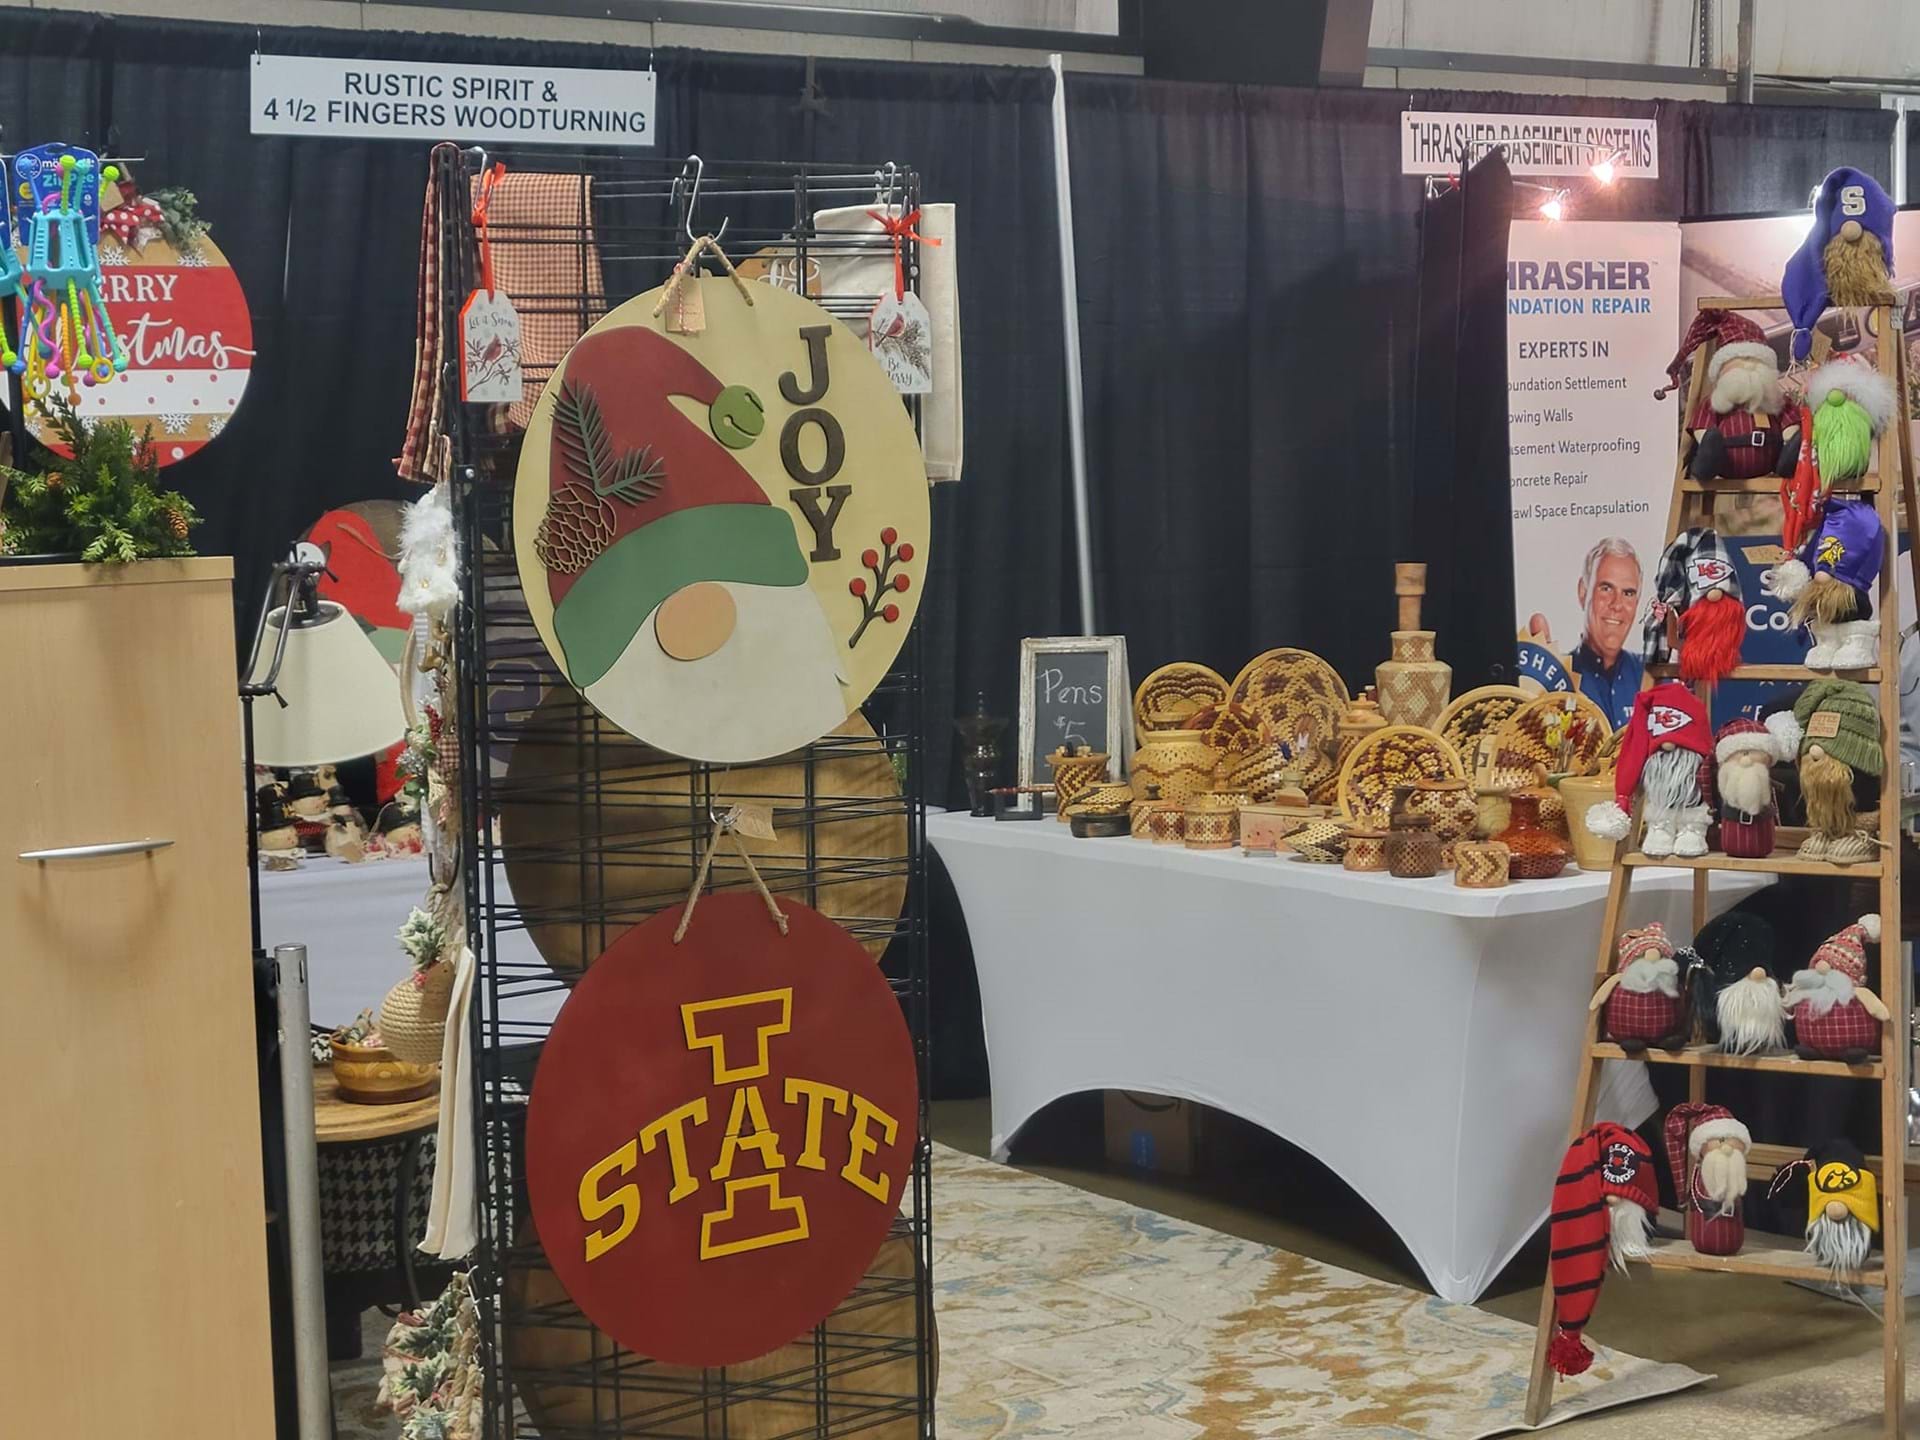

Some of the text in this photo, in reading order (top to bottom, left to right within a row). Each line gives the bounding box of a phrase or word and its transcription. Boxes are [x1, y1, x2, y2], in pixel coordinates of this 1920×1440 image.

[344, 72, 558, 102] RUSTIC SPIRIT &
[264, 98, 279, 121] 4
[328, 100, 446, 126] FINGERS
[454, 105, 646, 133] WOODTURNING
[1501, 125, 1582, 165] BASEMENT
[1841, 186, 1866, 216] S
[1592, 297, 1651, 314] REPAIR
[1519, 341, 1609, 359] EXPERTS IN
[1565, 376, 1627, 390] Settlement
[1543, 408, 1574, 422] Walls
[777, 325, 852, 563] JOY
[1558, 437, 1641, 457] Waterproofing
[1554, 471, 1588, 488] Repair
[1535, 504, 1568, 521] Space
[1570, 500, 1649, 518] Encapsulation
[1036, 668, 1103, 705] Pens
[1053, 714, 1087, 746] $5
[578, 1077, 899, 1263] STATE
